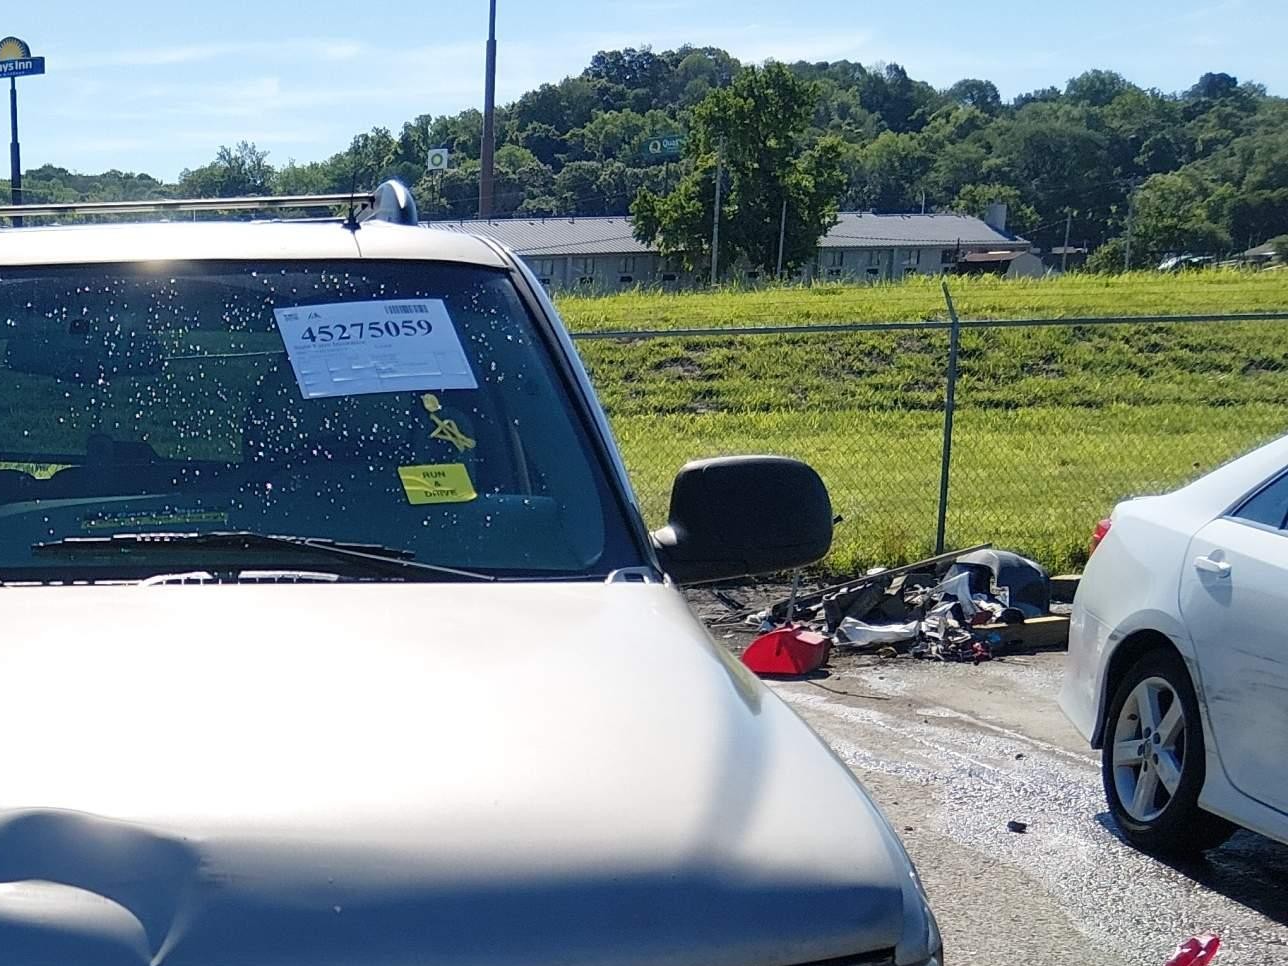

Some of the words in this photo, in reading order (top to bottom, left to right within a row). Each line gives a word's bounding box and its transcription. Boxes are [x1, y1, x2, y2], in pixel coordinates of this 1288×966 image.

[15, 60, 32, 70] Inn
[301, 319, 433, 343] 45275059
[422, 471, 446, 479] RUN
[424, 489, 458, 498] DRIVE
